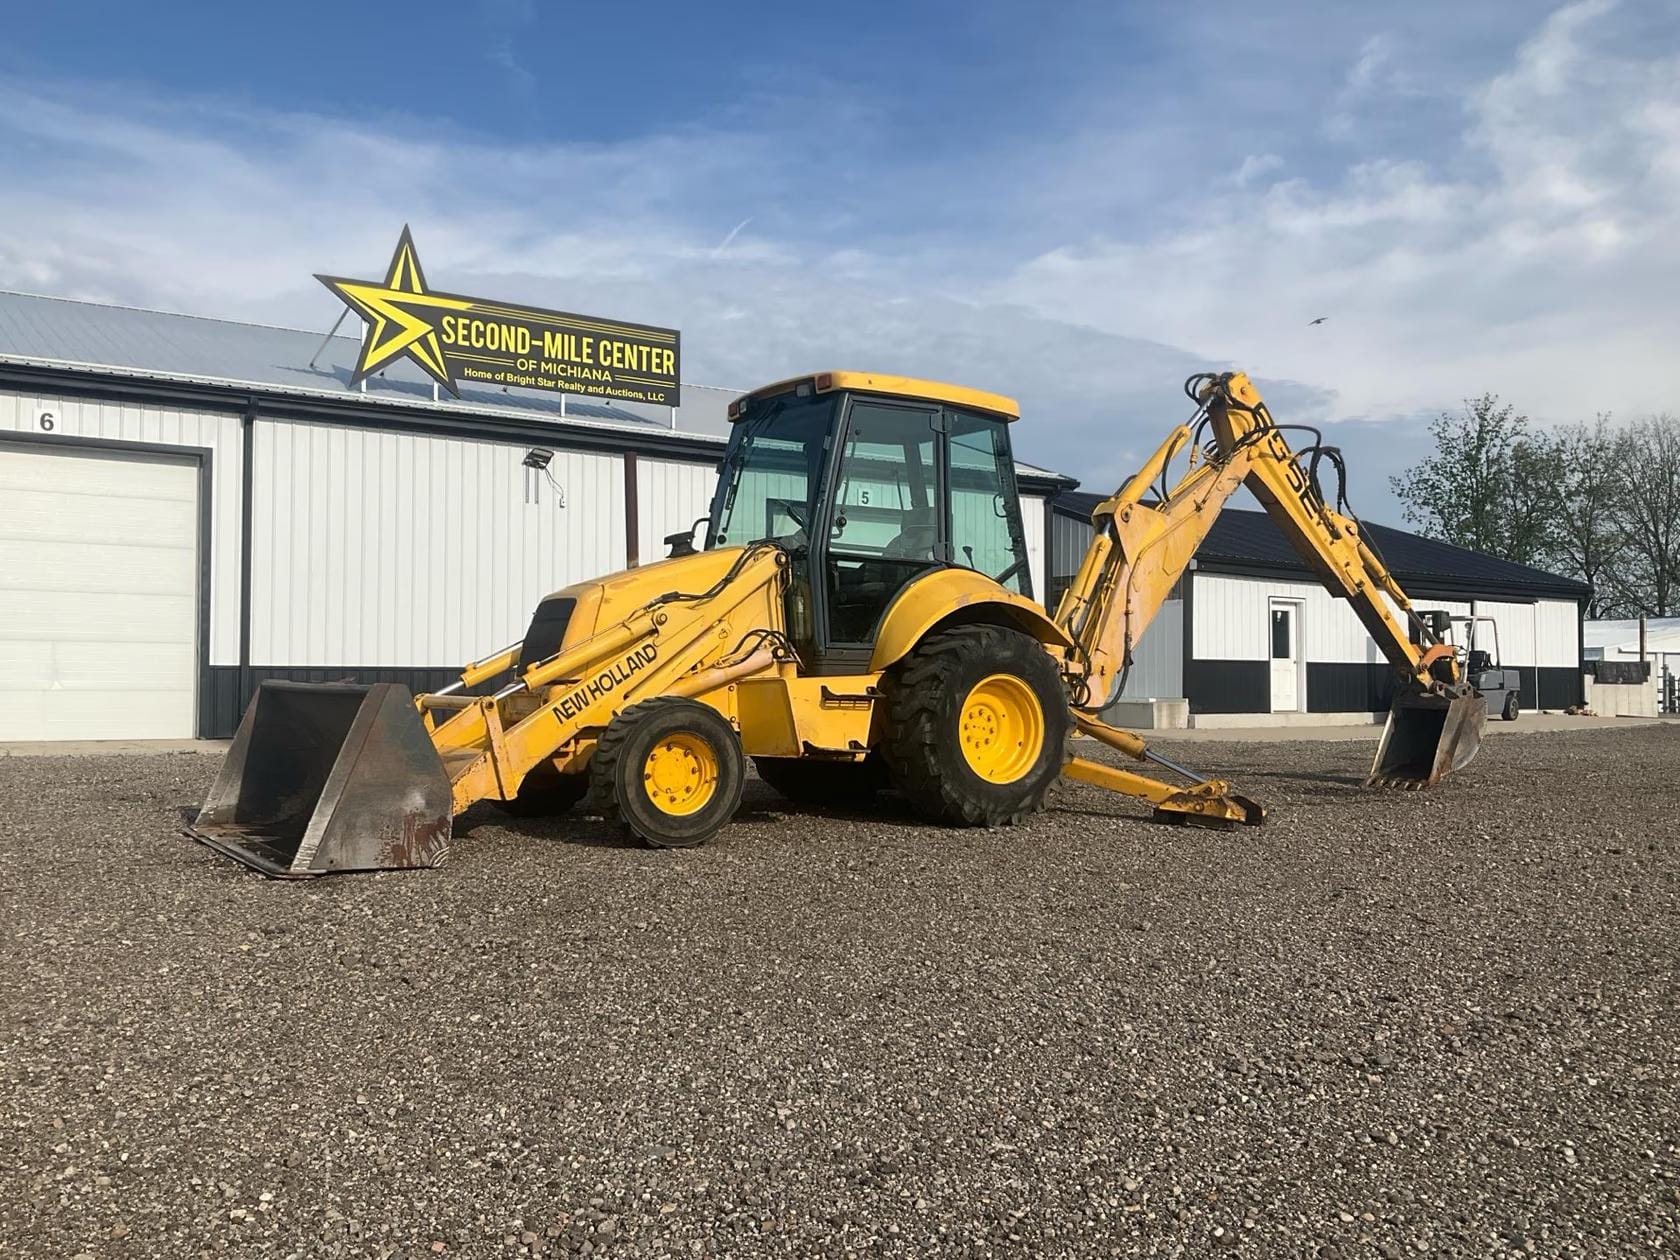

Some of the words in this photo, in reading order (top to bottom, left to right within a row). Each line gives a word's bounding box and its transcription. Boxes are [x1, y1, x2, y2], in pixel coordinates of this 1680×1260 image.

[442, 316, 593, 364] SECOND-MILE
[599, 340, 675, 375] CENTER
[464, 368, 492, 379] Home
[495, 372, 505, 380] of
[507, 373, 535, 385] Bright
[537, 377, 555, 387] Star
[558, 380, 585, 393] Realty
[587, 384, 604, 394] and
[606, 387, 646, 400] Auctions,
[648, 392, 665, 401] LLC
[517, 359, 537, 371] OF
[541, 362, 612, 382] MICHIANA
[40, 413, 54, 431] 6
[862, 491, 869, 504] 5
[552, 689, 590, 724] NEW
[587, 644, 657, 700] HOLLAND
